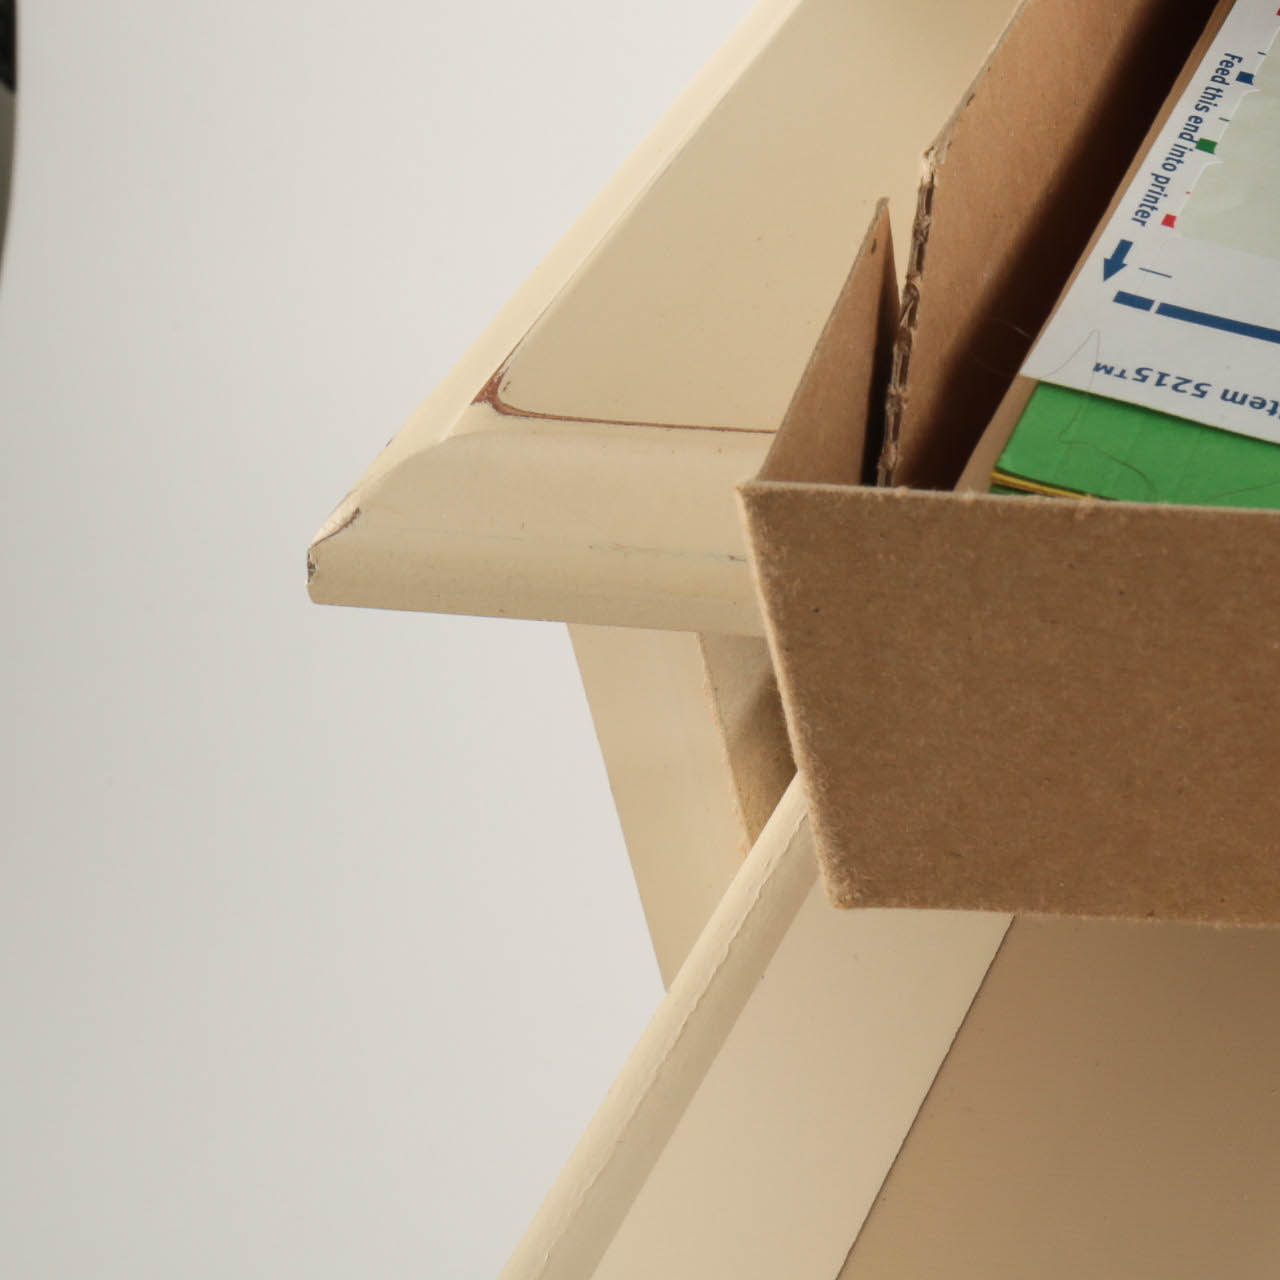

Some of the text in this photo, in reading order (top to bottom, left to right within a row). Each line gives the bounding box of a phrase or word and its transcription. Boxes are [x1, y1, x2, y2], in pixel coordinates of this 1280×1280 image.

[1131, 53, 1242, 227] Feed this end into printer
